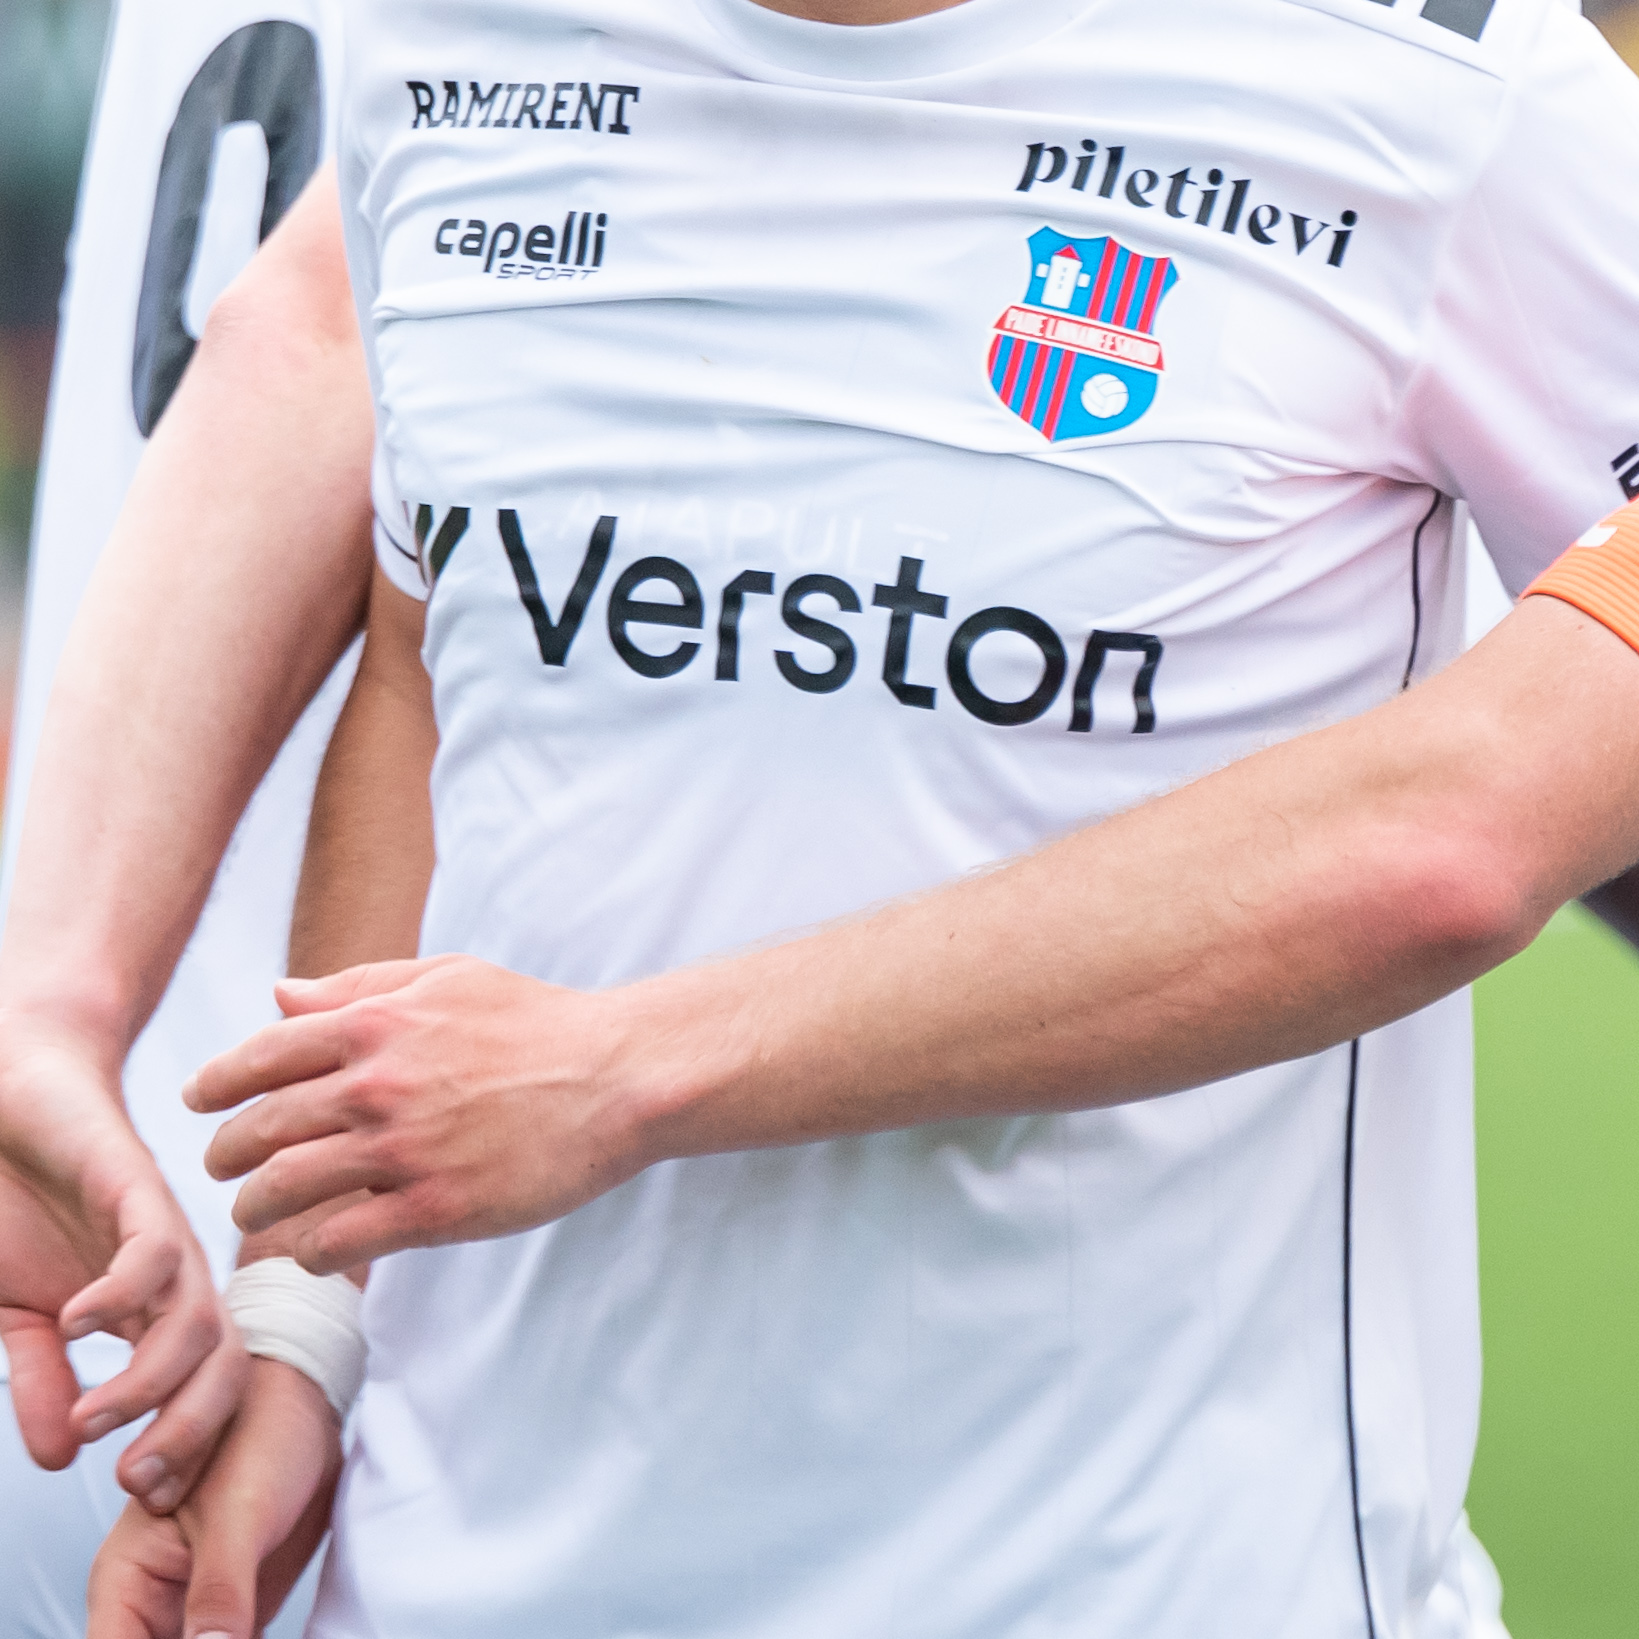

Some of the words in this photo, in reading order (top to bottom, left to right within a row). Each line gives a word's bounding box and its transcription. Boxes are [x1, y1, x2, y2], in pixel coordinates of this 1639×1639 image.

[405, 80, 641, 135] RAMIRENT
[1015, 138, 1359, 268] piletilevi
[434, 211, 608, 274] capelli
[496, 263, 599, 281] SPORT
[496, 507, 1164, 734] Verston
